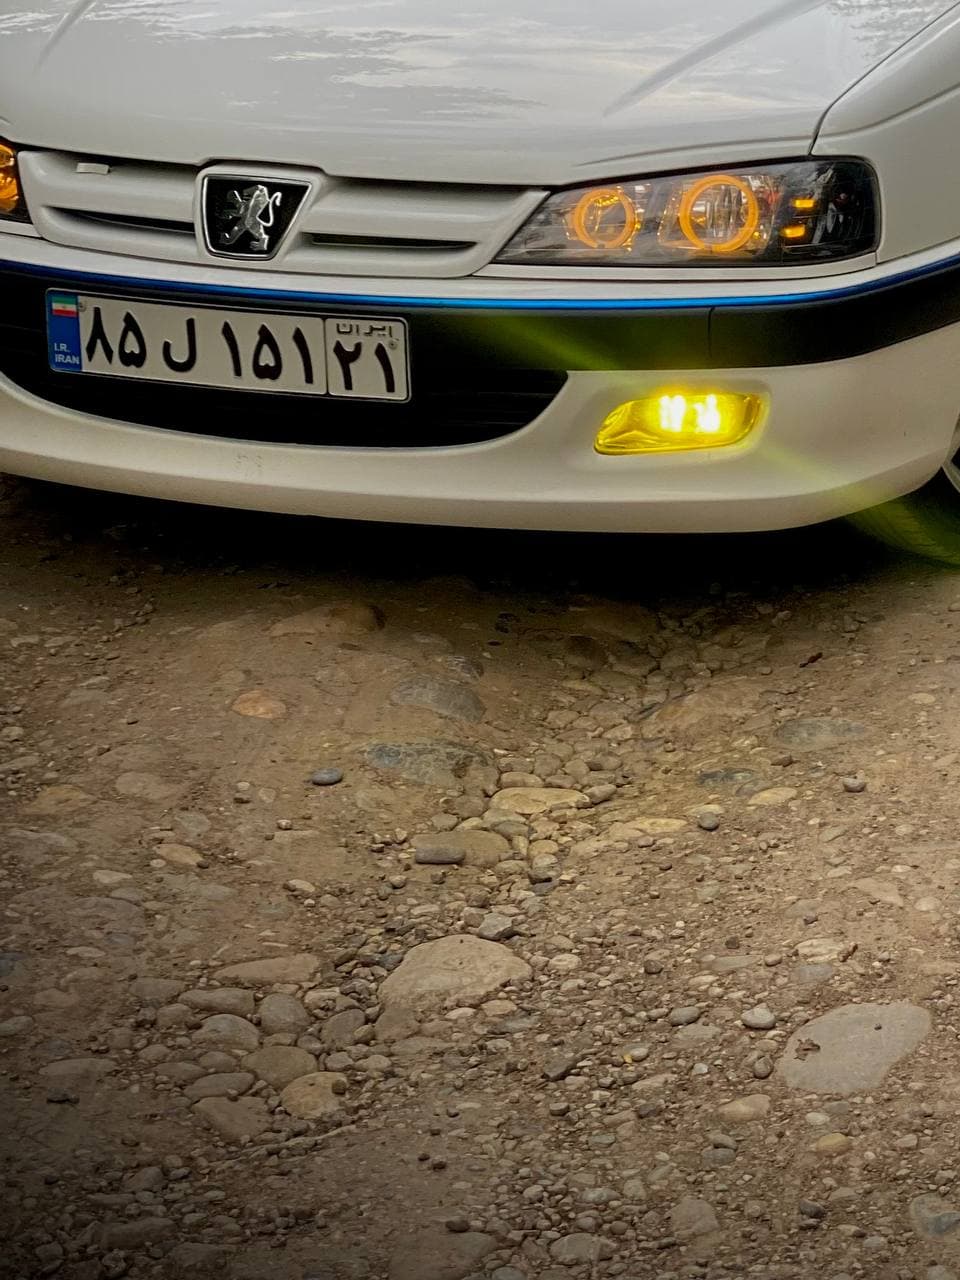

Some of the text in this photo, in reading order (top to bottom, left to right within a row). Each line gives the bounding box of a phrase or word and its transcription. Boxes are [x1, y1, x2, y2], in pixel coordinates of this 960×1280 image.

[336, 323, 393, 337] ایران
[54, 342, 71, 353] I.R.
[54, 354, 80, 365] IRAN
[333, 340, 395, 393] ۲۱
